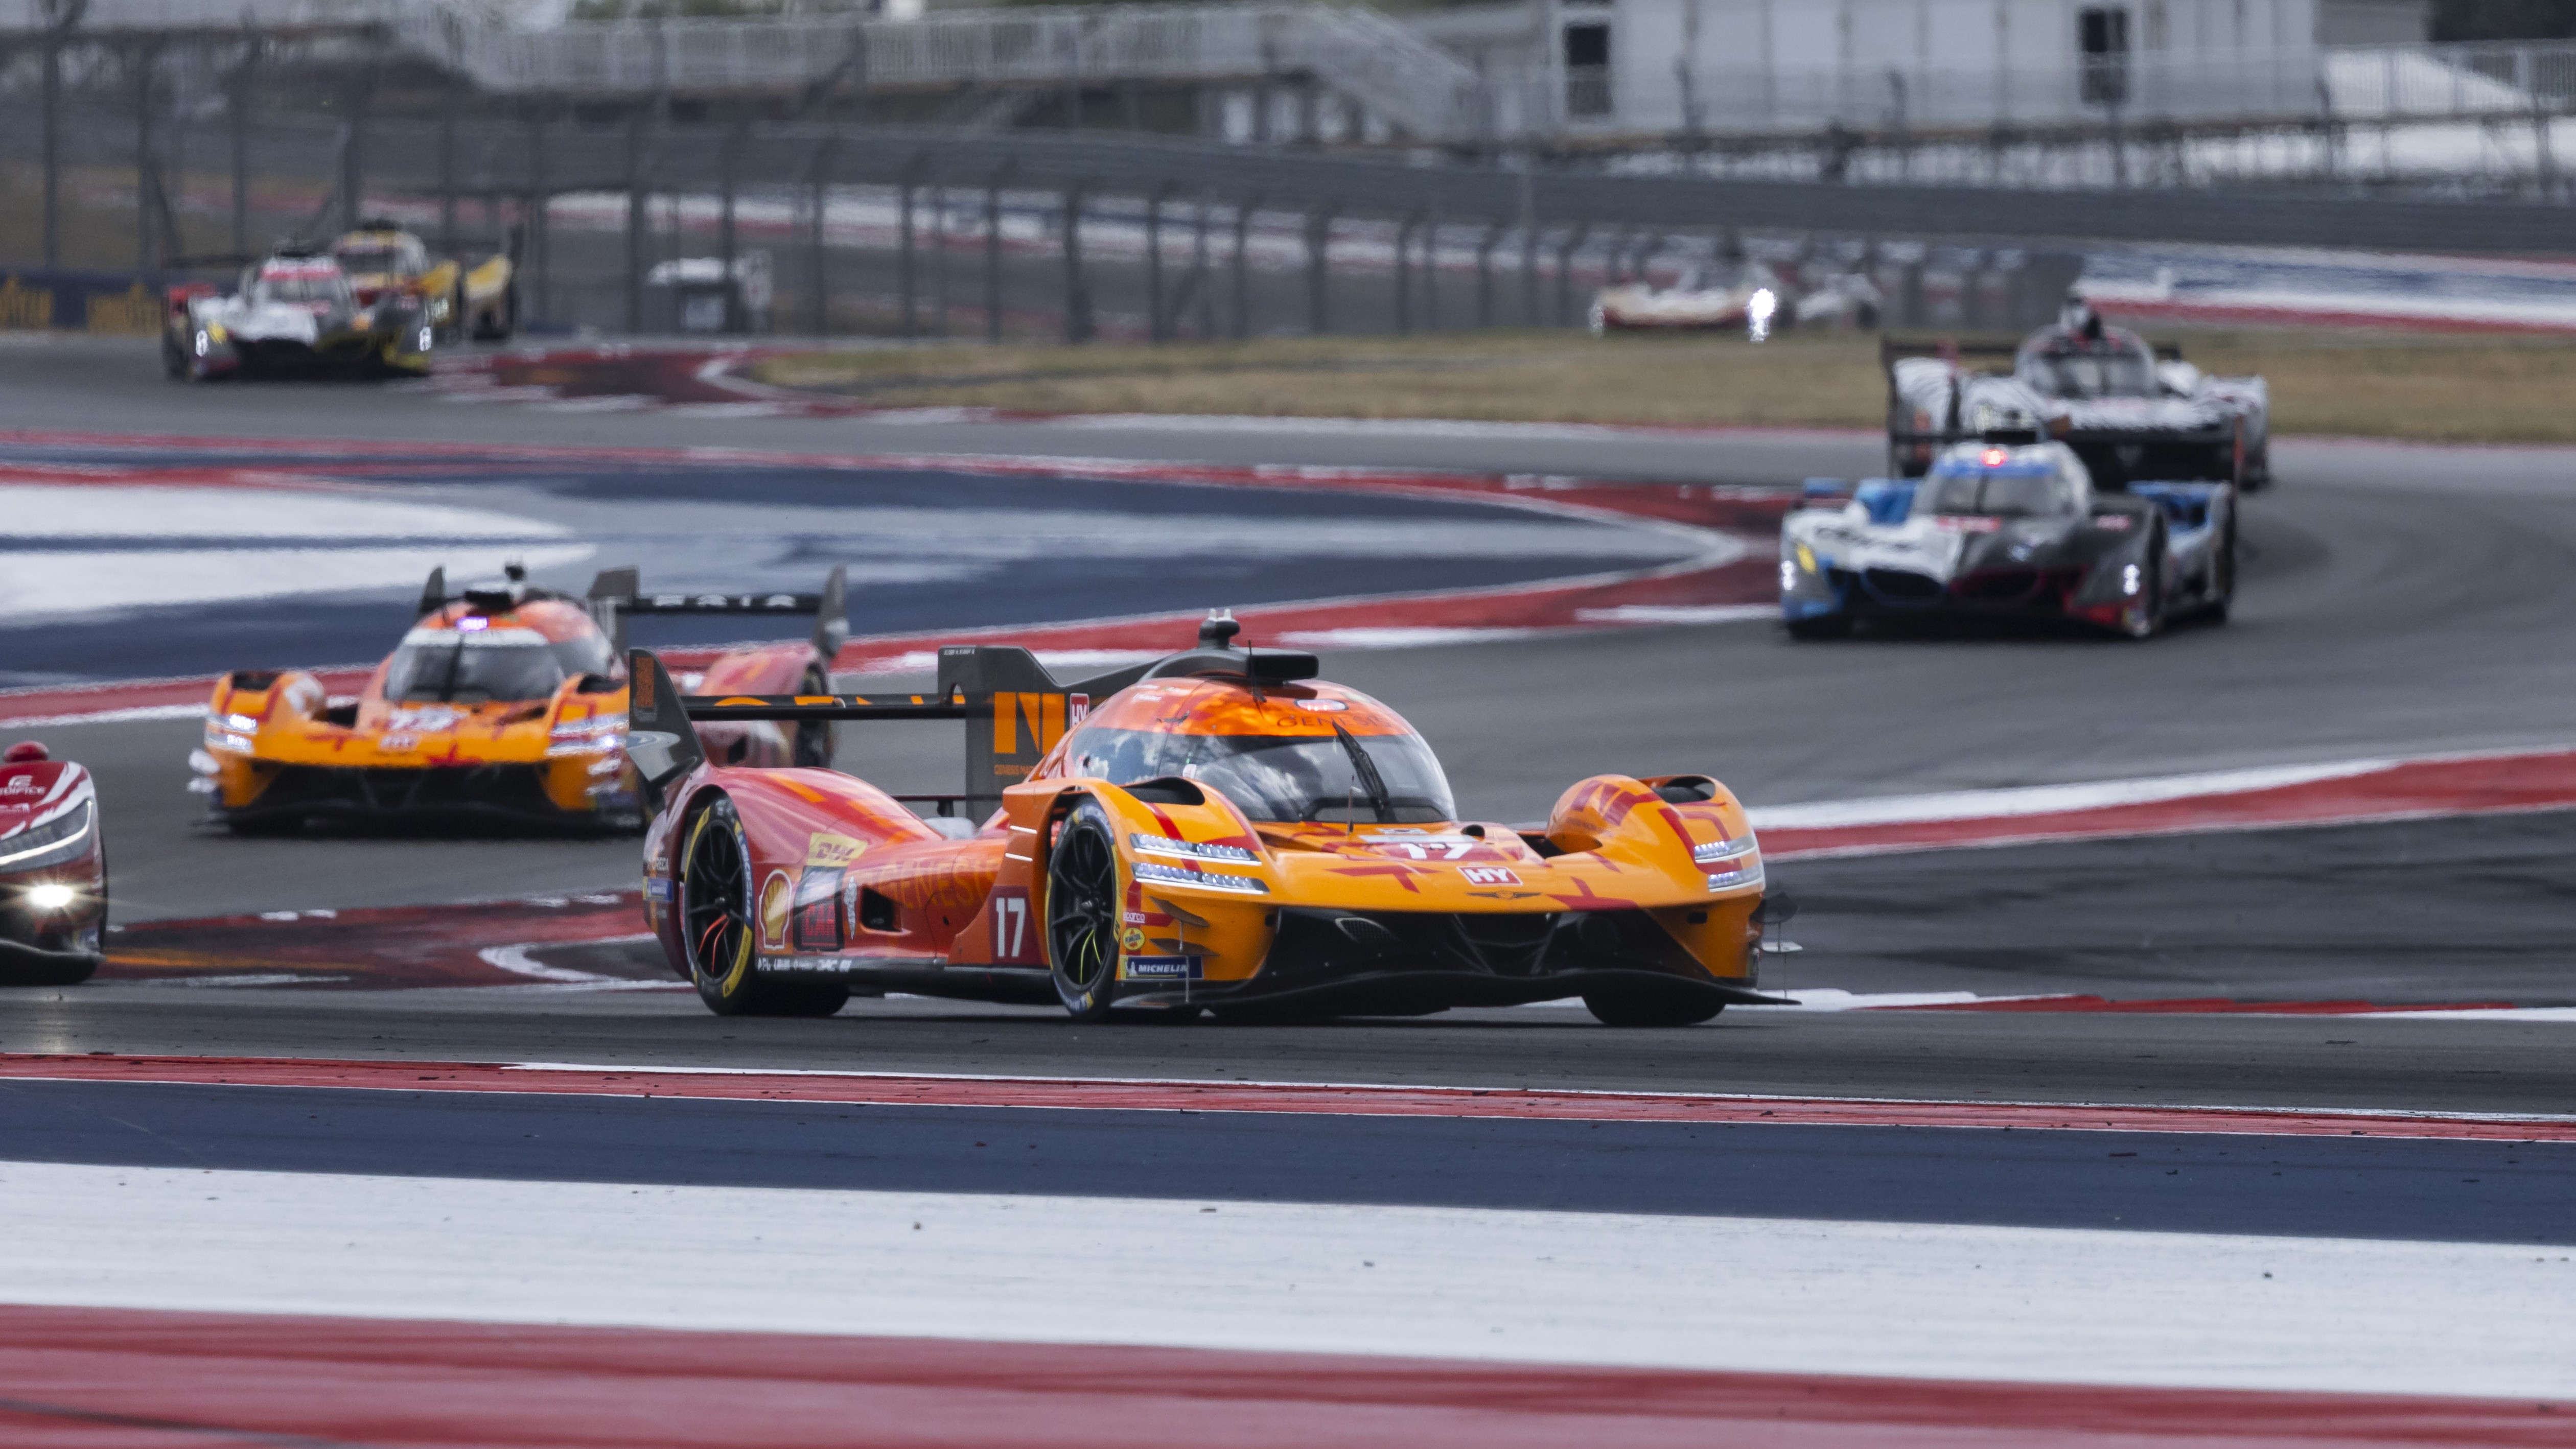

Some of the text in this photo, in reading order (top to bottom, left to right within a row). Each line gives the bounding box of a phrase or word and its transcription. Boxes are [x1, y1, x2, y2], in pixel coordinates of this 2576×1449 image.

[816, 842, 855, 861] DHL
[1401, 843, 1472, 859] 17
[1466, 868, 1509, 882] HY
[996, 898, 1025, 958] 17
[1139, 965, 1188, 973] MICHELIN
